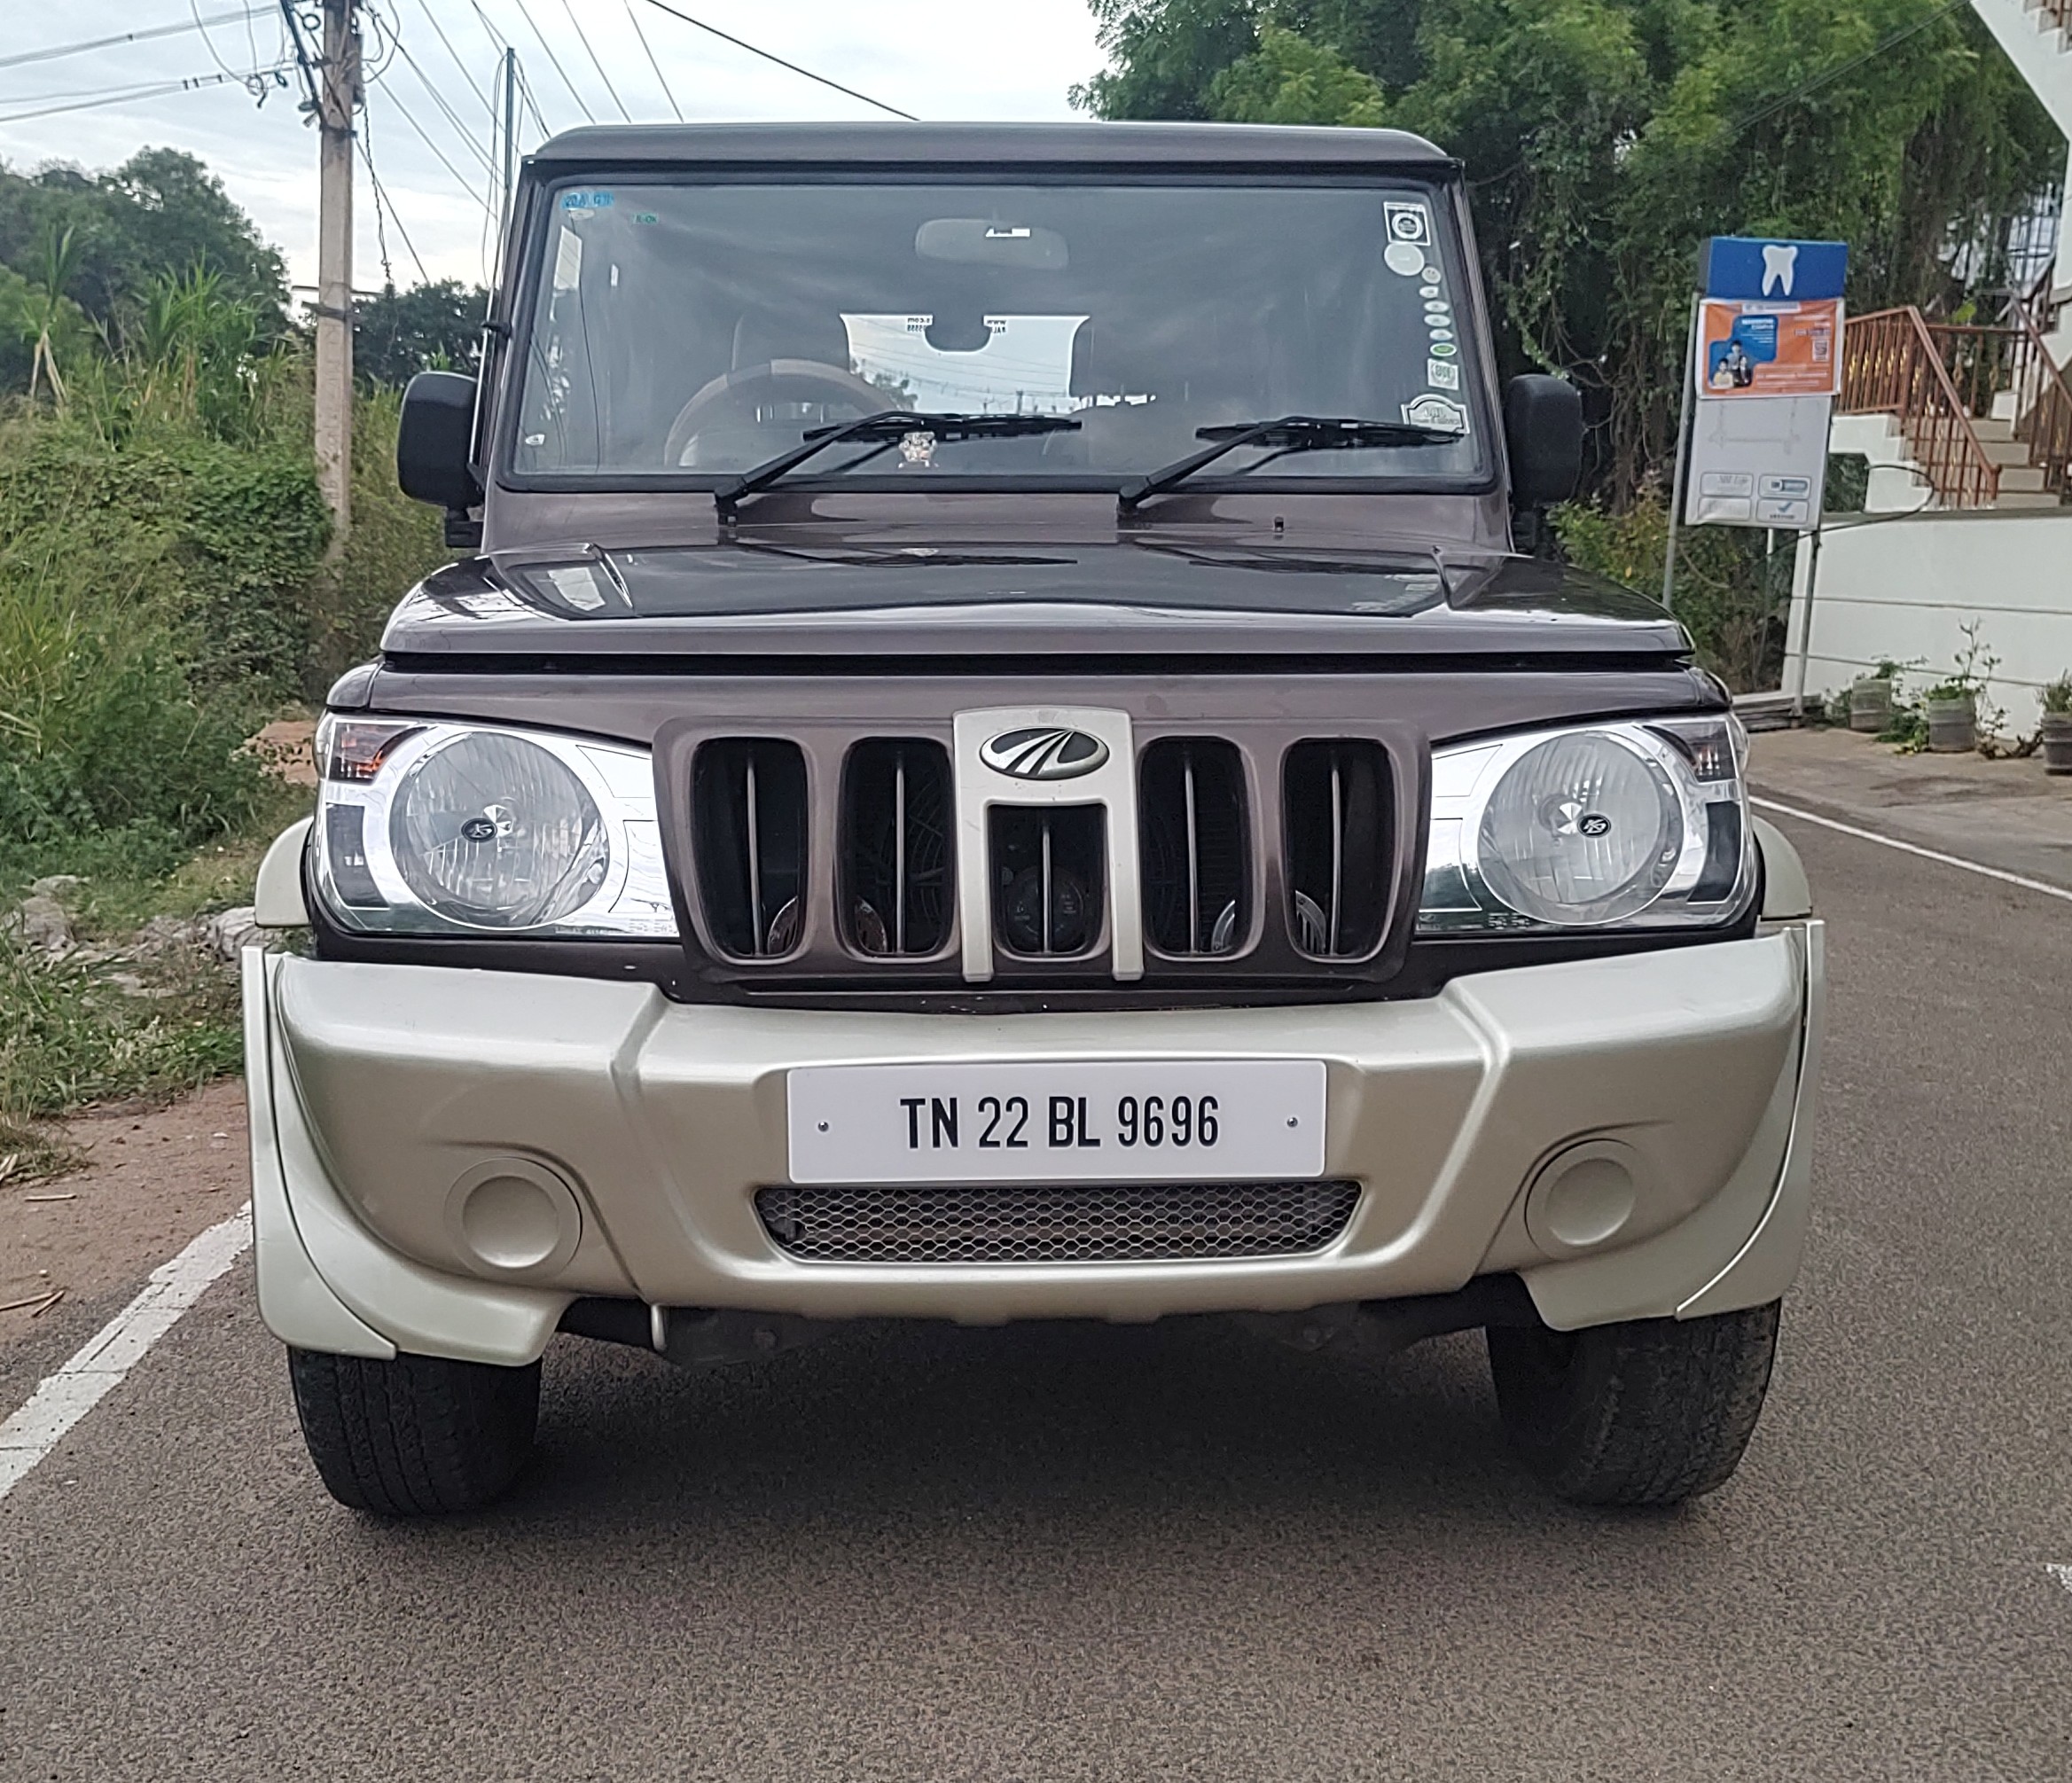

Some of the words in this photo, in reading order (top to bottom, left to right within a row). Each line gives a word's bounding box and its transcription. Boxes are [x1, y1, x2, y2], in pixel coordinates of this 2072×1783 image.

[900, 1098, 959, 1149] TN
[977, 1097, 1028, 1148] 22
[1048, 1097, 1101, 1147] BL
[1117, 1096, 1219, 1146] 9696
